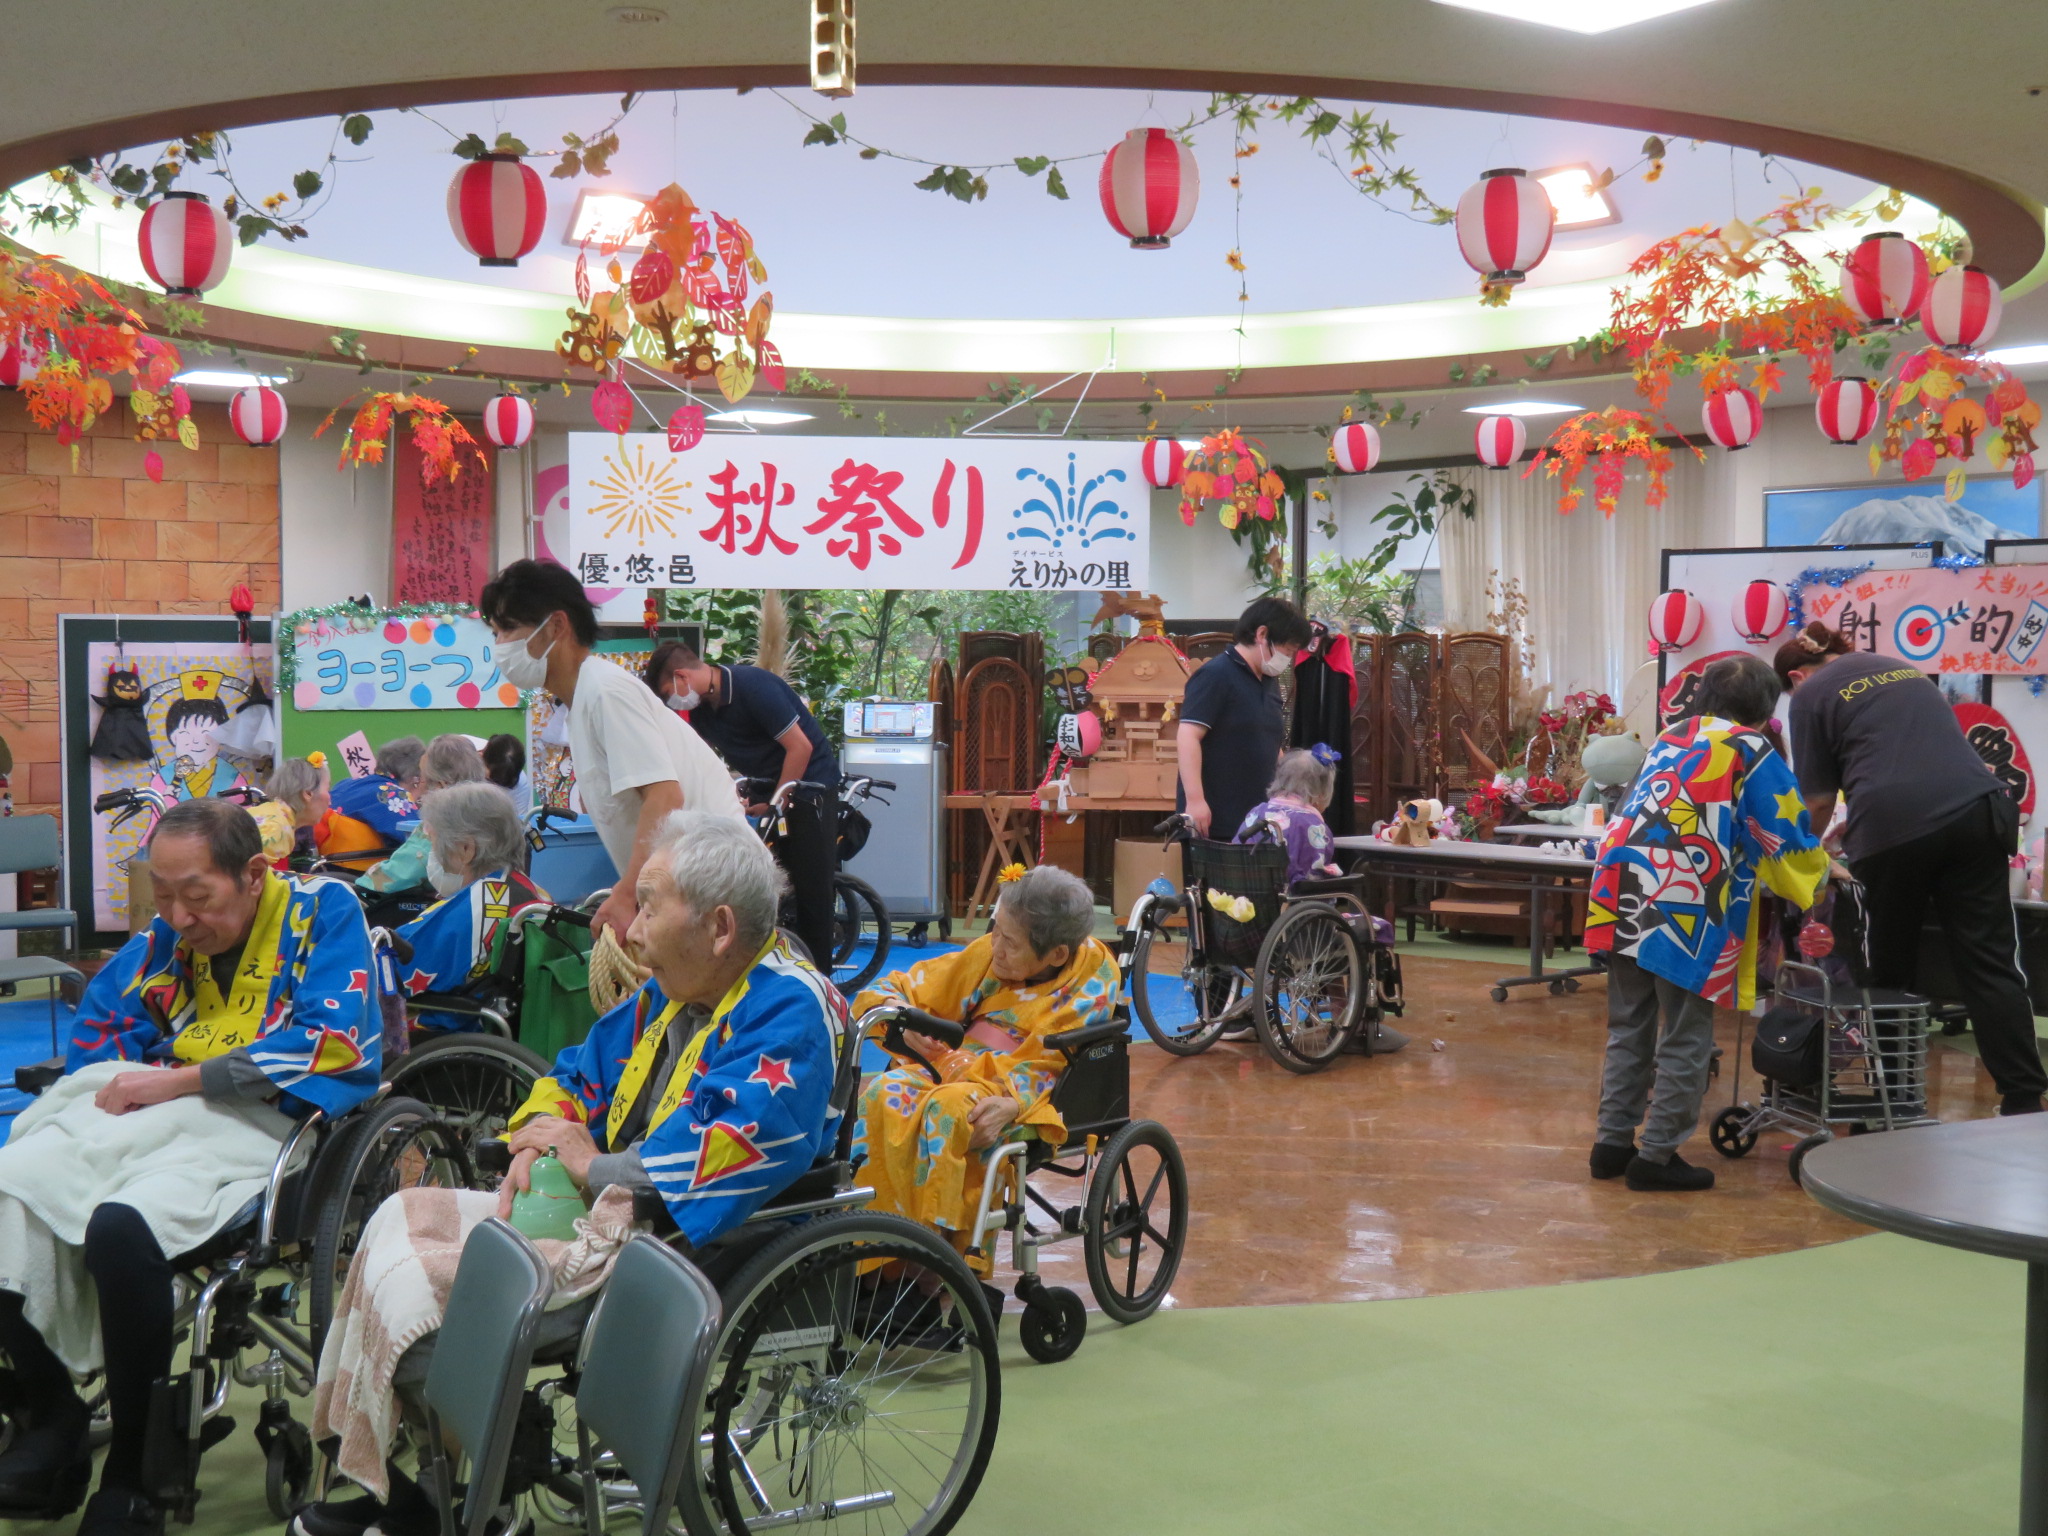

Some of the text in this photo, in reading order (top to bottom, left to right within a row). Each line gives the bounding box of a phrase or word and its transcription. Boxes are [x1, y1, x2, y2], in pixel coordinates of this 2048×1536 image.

[699, 458, 985, 571] 秋祭り
[1012, 550, 1064, 558] デイサービス
[1910, 551, 1928, 559] PLUS
[578, 552, 696, 585] 優・悠・邑
[1009, 559, 1132, 588] えりかの里
[1839, 677, 1874, 702] ROY
